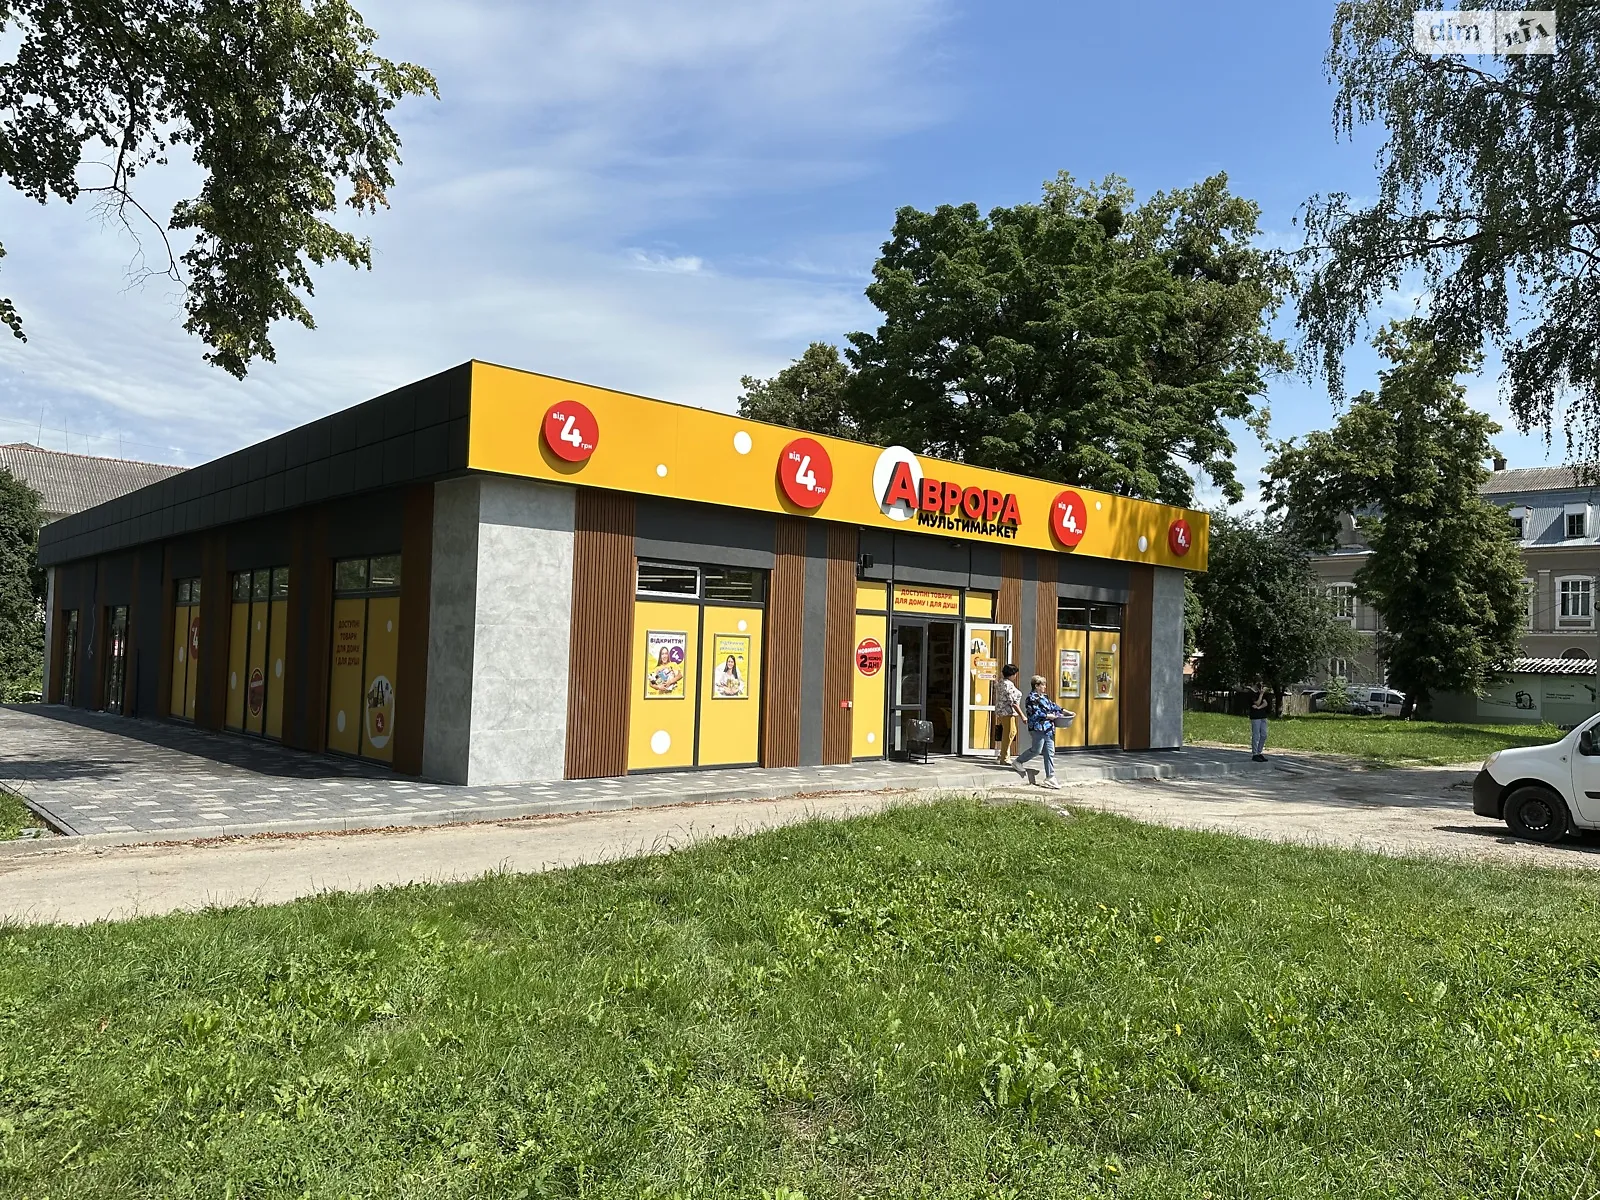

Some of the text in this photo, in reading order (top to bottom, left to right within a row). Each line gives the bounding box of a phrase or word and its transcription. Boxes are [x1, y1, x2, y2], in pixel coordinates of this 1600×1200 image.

[552, 411, 565, 422] від
[560, 415, 582, 447] 4
[788, 451, 826, 494] від 4 грн
[1062, 504, 1076, 533] 4
[917, 512, 1018, 539] МУЛЬТИМАРКЕТ
[1177, 528, 1186, 547] 4
[900, 588, 953, 600] ДОСТУПНІ ТОВАРИ
[895, 597, 908, 605] ДЛЯ
[942, 601, 957, 609] ДУШІ
[340, 632, 357, 641] ТОВАРИ
[337, 644, 359, 653] ДЛЯ ДОМУ
[857, 647, 881, 655] НОВИНКИ
[338, 657, 347, 666] ДЛЯ
[859, 654, 868, 668] 2
[867, 661, 880, 669] ДНІ
